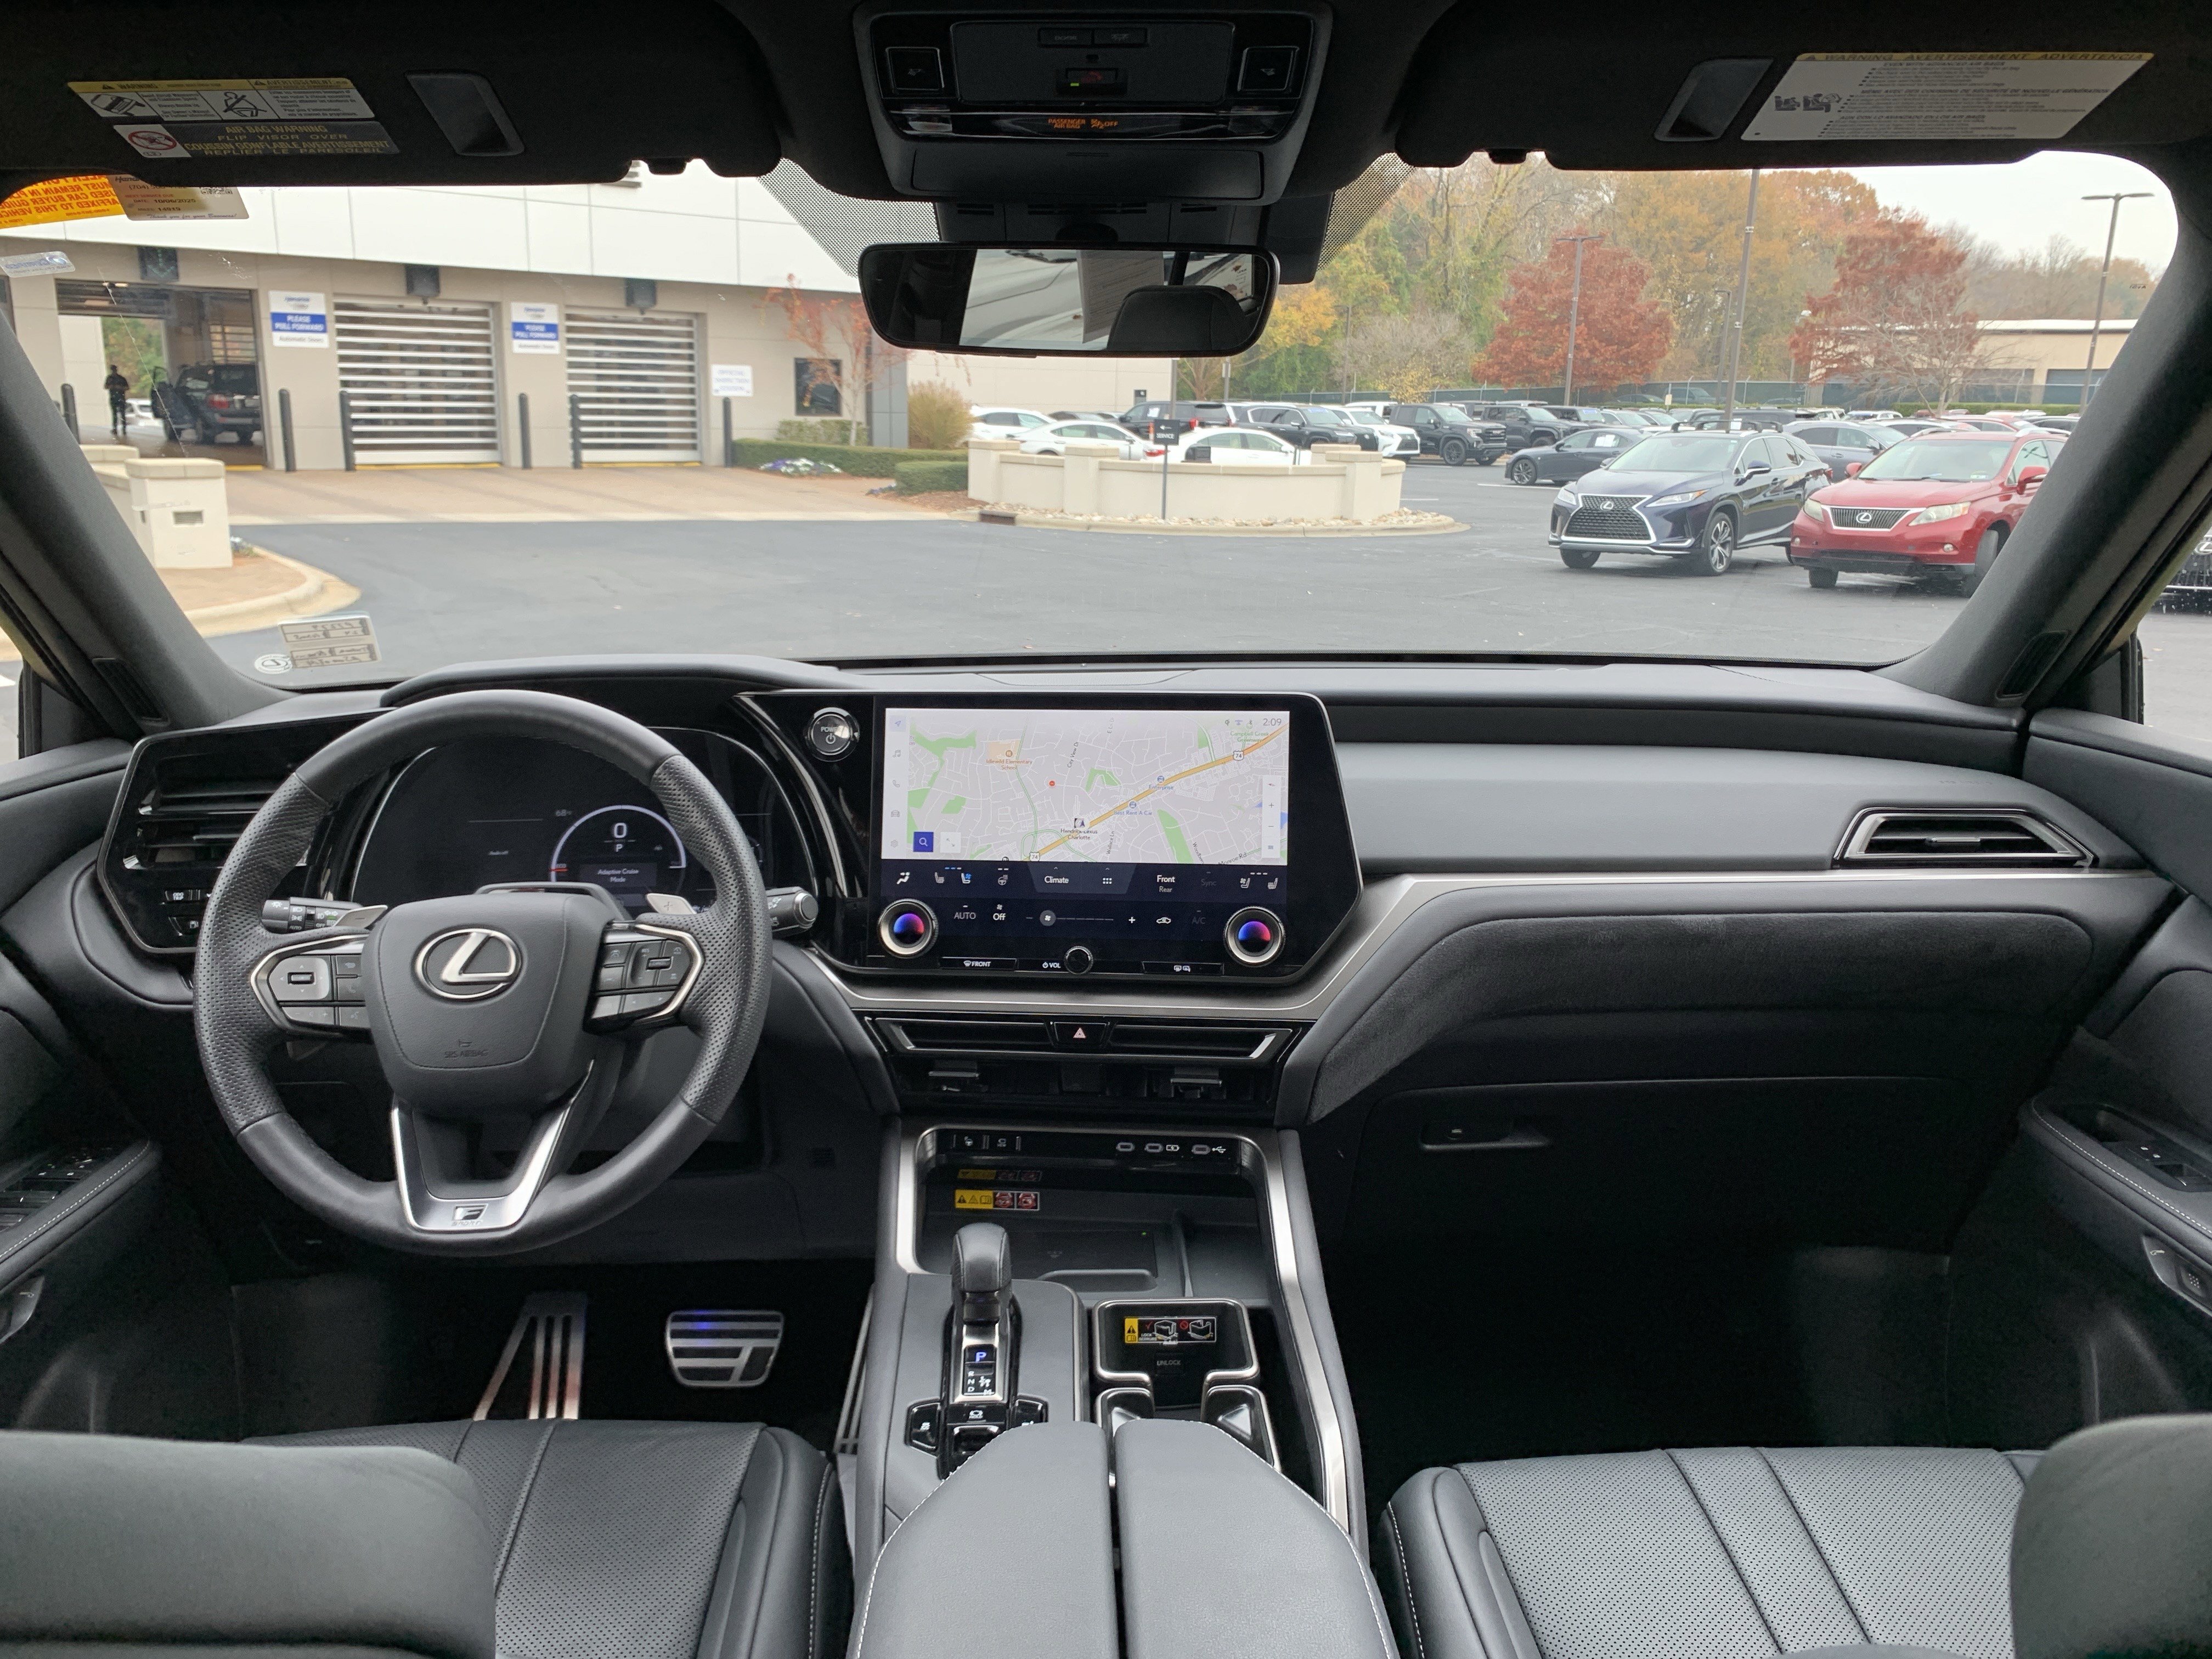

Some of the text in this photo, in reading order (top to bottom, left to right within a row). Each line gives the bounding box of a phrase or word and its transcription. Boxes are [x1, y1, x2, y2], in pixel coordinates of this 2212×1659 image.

[225, 125, 328, 133] AIR BAG WARNING
[301, 140, 390, 149] AVERTISSEMENT
[275, 322, 324, 331] PULL FORWARD
[1263, 718, 1282, 726] 2:09
[613, 822, 628, 839] 0
[615, 844, 623, 853] P
[1218, 856, 1239, 865] Monroe
[1044, 876, 1069, 884] Climate
[1156, 874, 1176, 883] Front
[1200, 878, 1217, 888] Sync
[954, 912, 977, 920] AUTO
[993, 912, 1006, 921] Off
[1192, 917, 1206, 926] A/C
[975, 1351, 987, 1362] P
